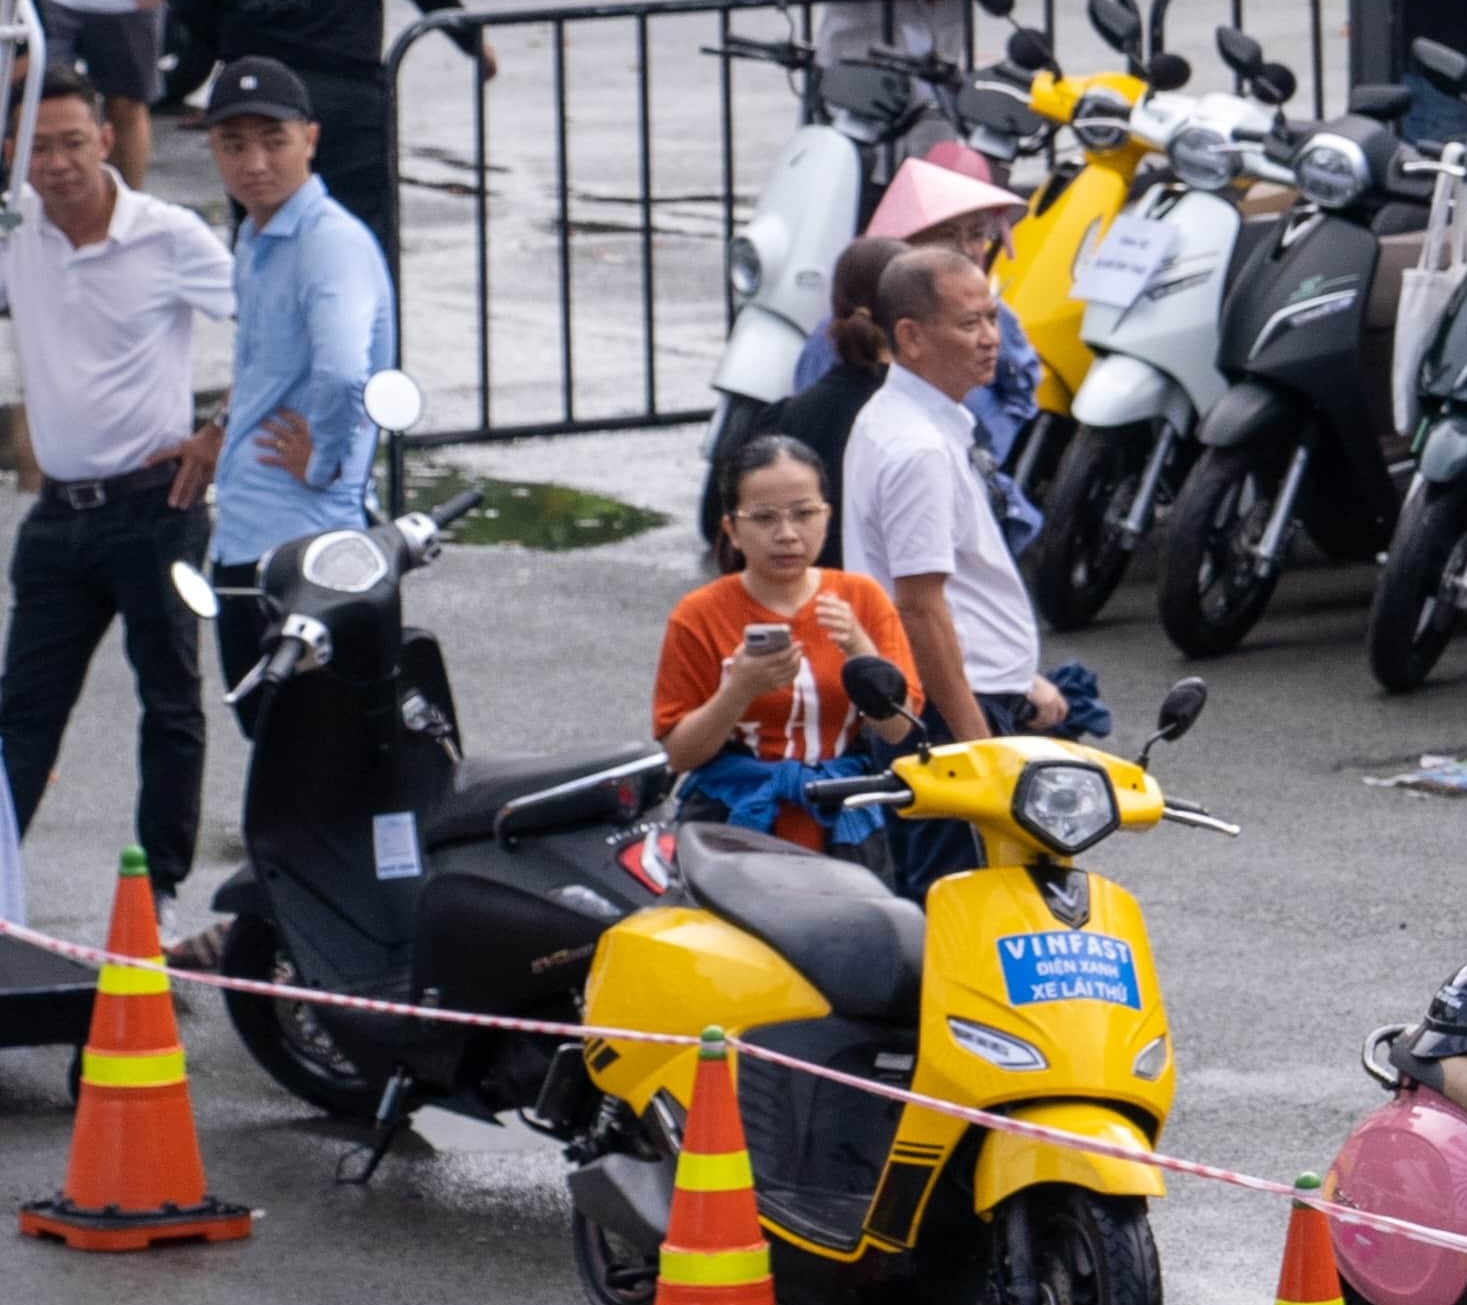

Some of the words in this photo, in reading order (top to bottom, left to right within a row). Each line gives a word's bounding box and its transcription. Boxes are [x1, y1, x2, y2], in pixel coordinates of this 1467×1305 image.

[1004, 934, 1130, 964] VINFAST
[1080, 959, 1120, 979] XANH
[1030, 981, 1059, 1001] XE
